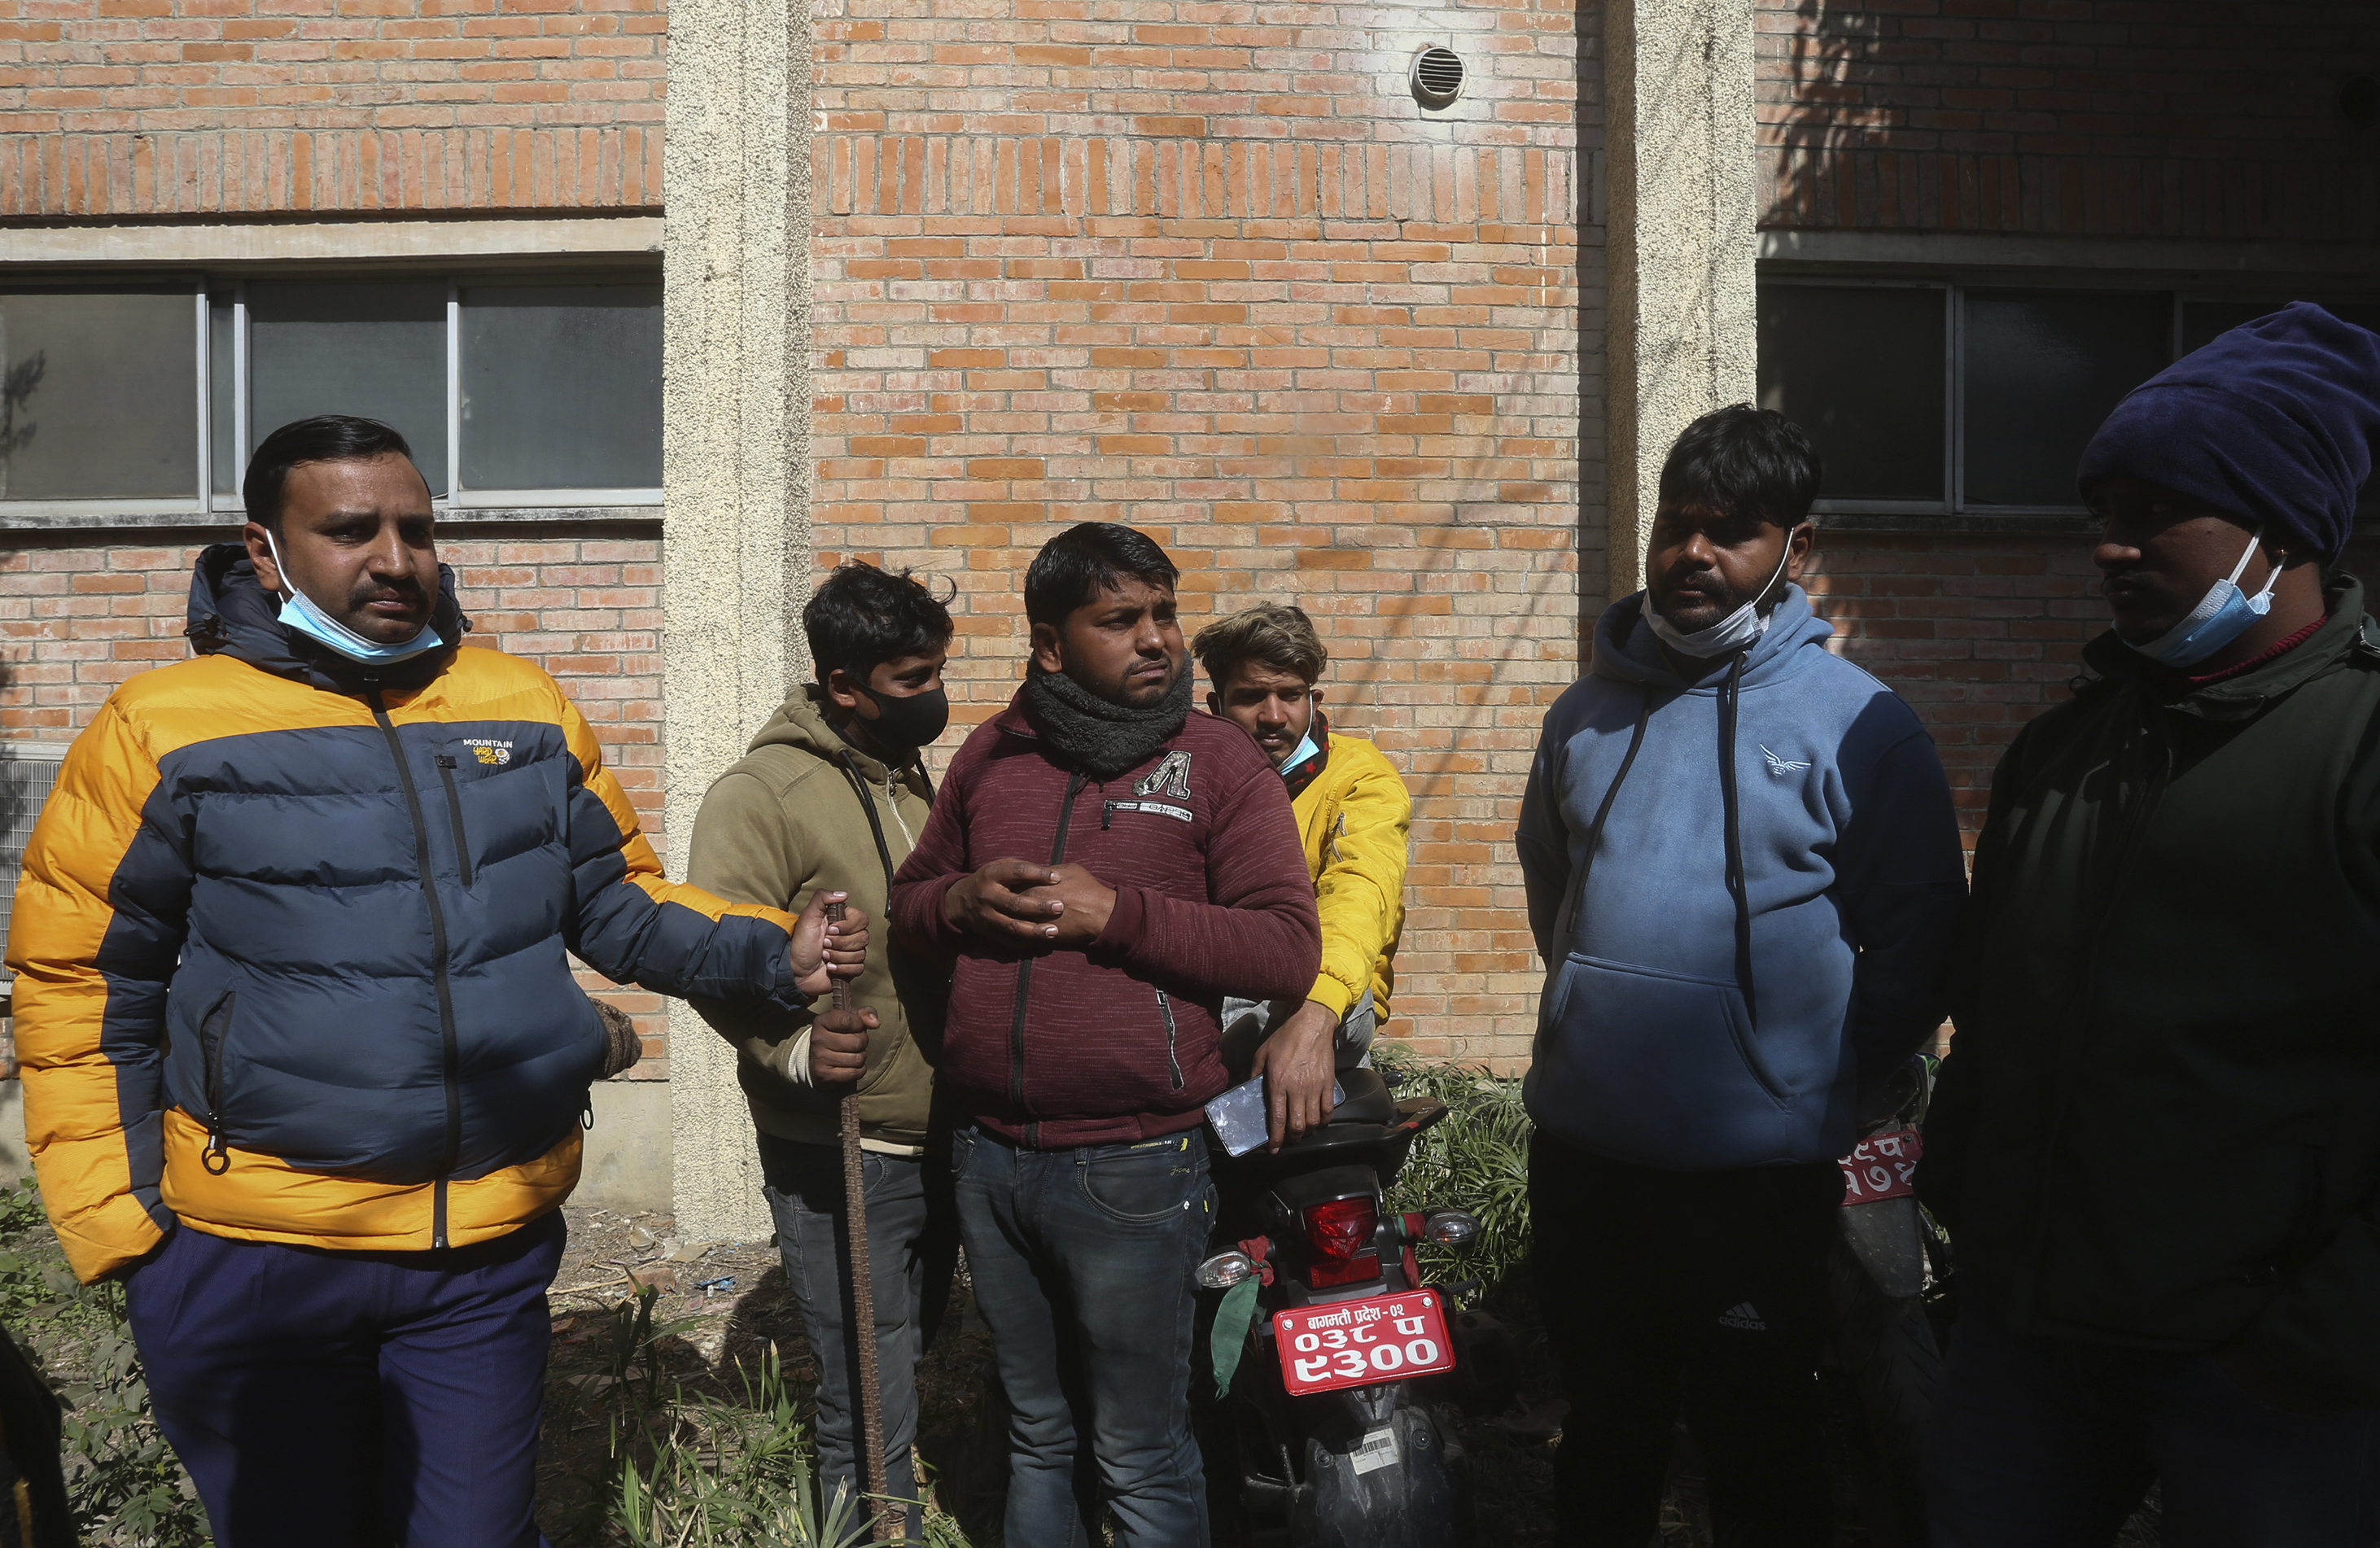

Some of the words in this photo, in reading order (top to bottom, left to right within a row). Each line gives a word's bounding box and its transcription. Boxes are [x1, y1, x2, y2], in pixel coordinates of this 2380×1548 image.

[463, 739, 513, 748] MOUNTAIN
[473, 747, 492, 756] HARD
[478, 754, 498, 765] WEAR
[1307, 1309, 1352, 1330] बागमती
[1393, 1315, 1425, 1336] प
[1718, 1316, 1765, 1331] adidas
